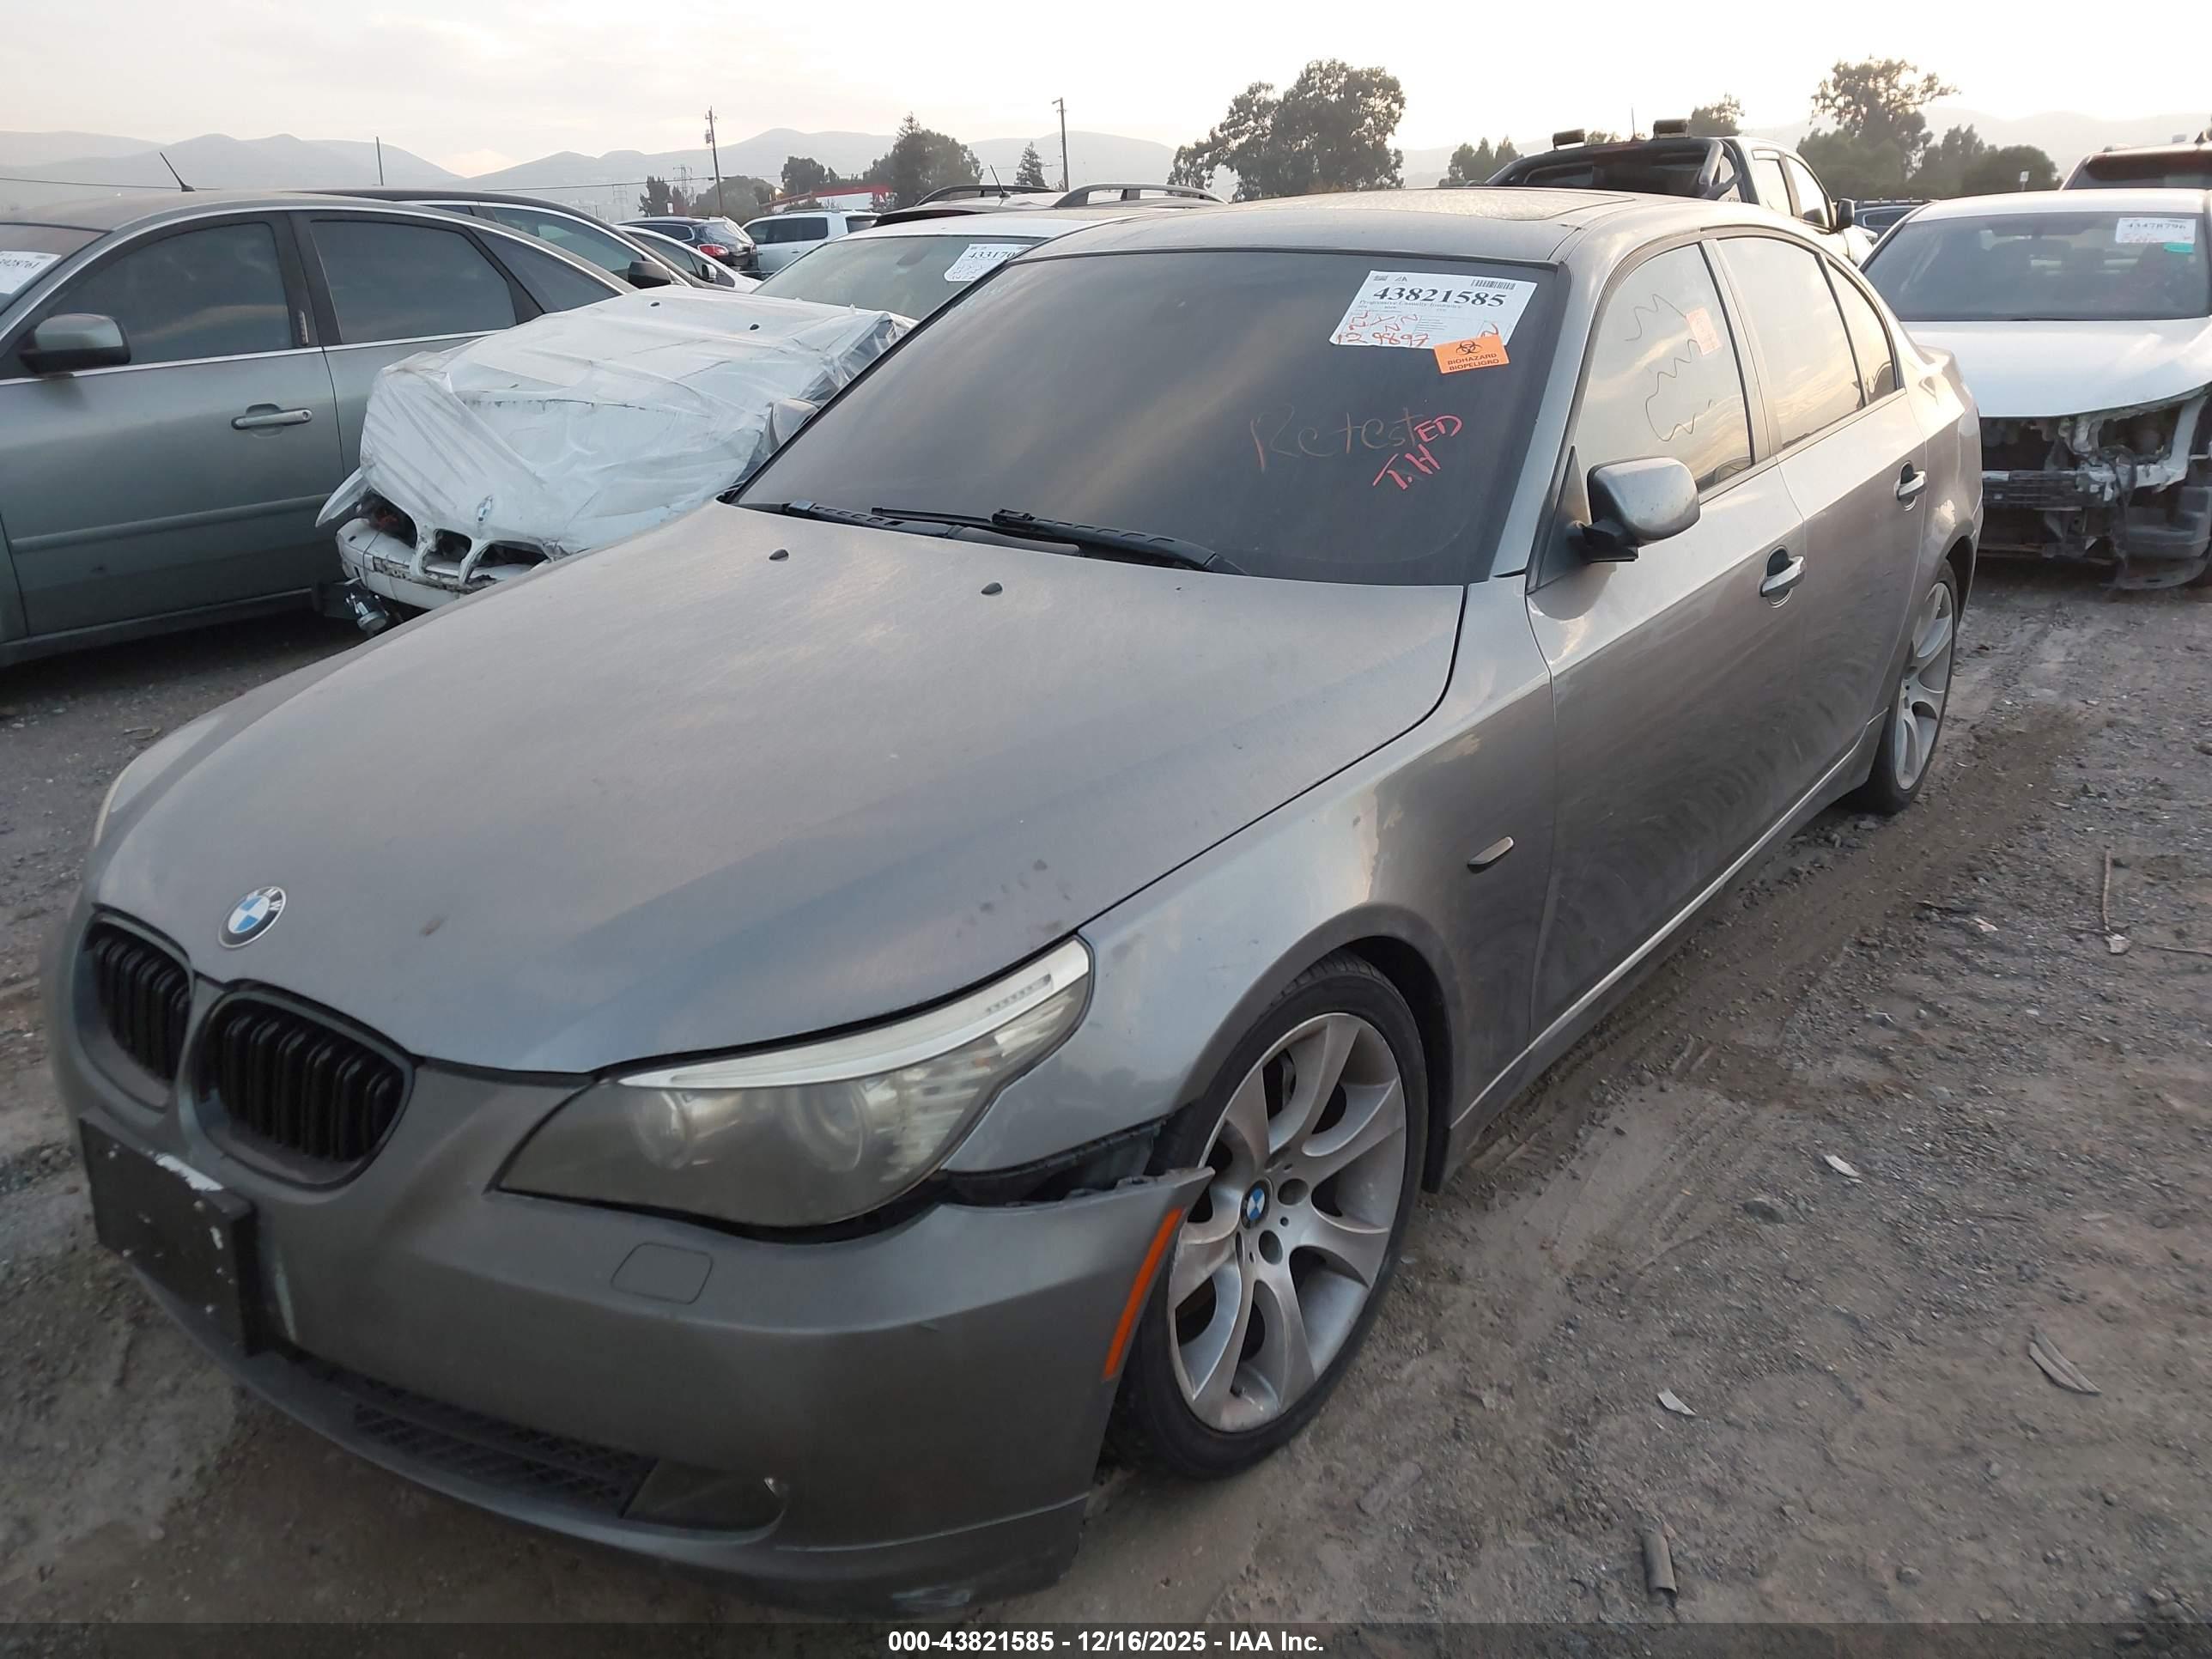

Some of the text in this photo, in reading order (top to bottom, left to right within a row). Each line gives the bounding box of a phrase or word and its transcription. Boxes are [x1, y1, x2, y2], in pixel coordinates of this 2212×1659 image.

[1374, 287, 1507, 307] 43821585
[1448, 353, 1498, 366] BIOHAZARD
[1449, 359, 1499, 371] BIOPELIGRO
